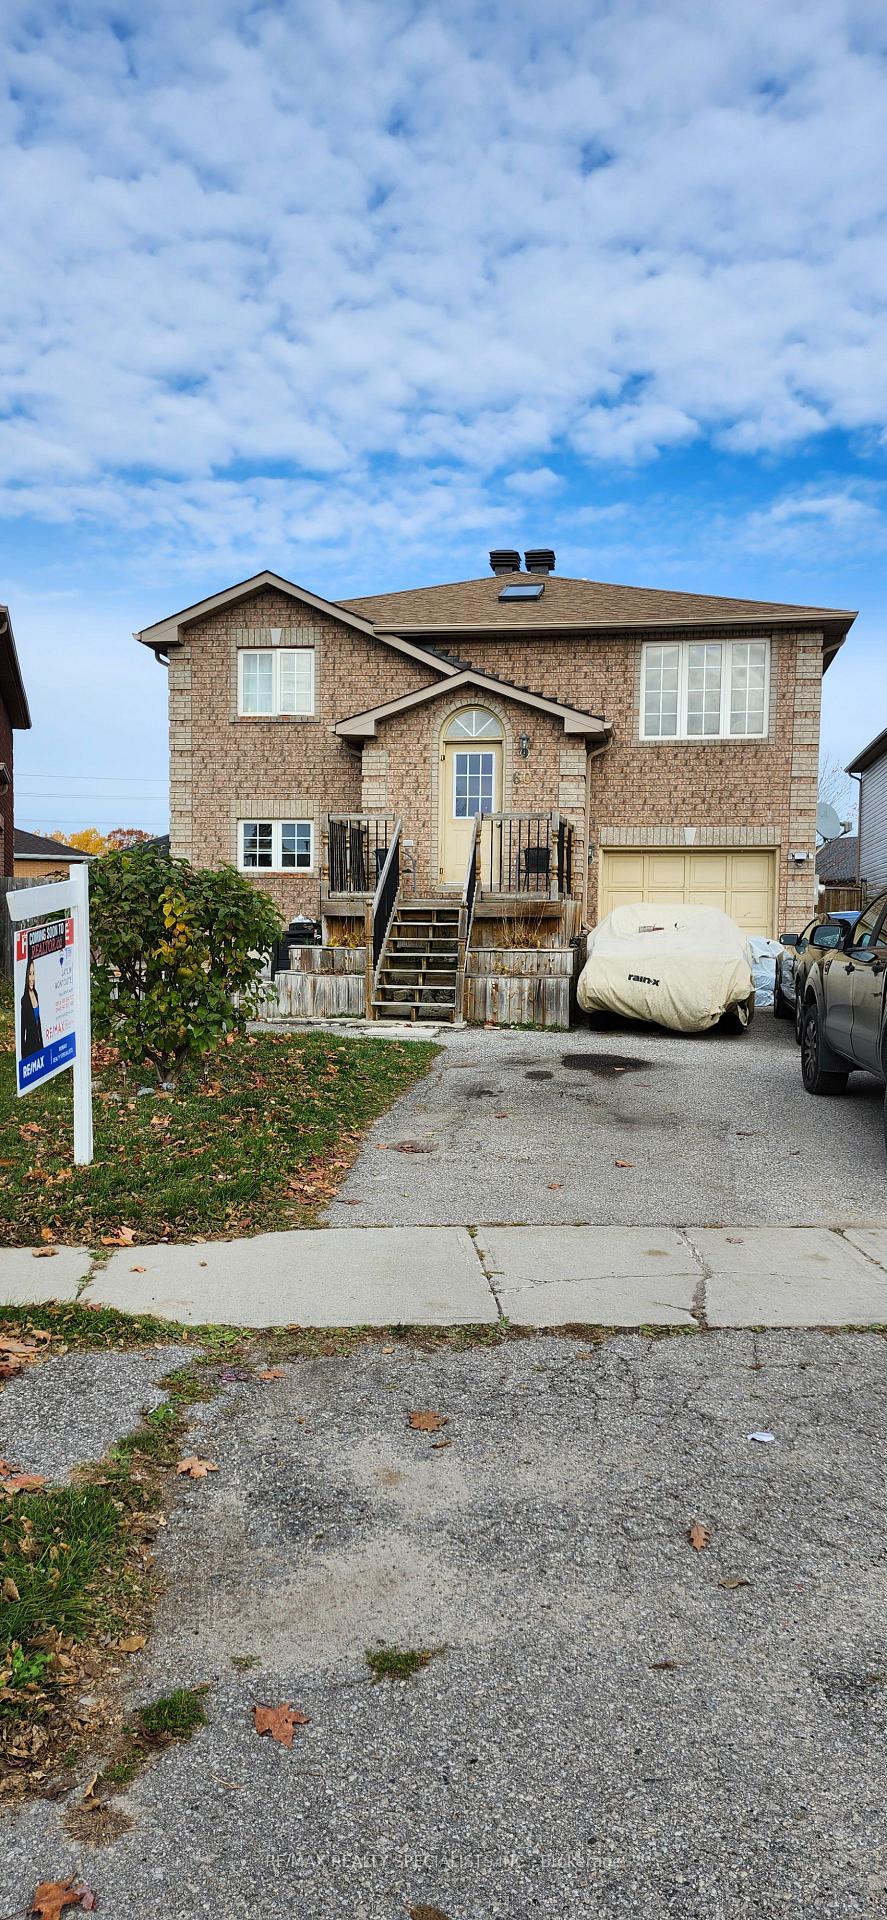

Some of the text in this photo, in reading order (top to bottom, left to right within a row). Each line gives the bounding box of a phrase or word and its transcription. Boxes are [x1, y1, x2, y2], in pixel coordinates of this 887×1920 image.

[29, 928, 47, 946] COMING
[46, 924, 59, 940] SOON
[58, 921, 65, 936] TO
[22, 1055, 45, 1079] RE/MAX
